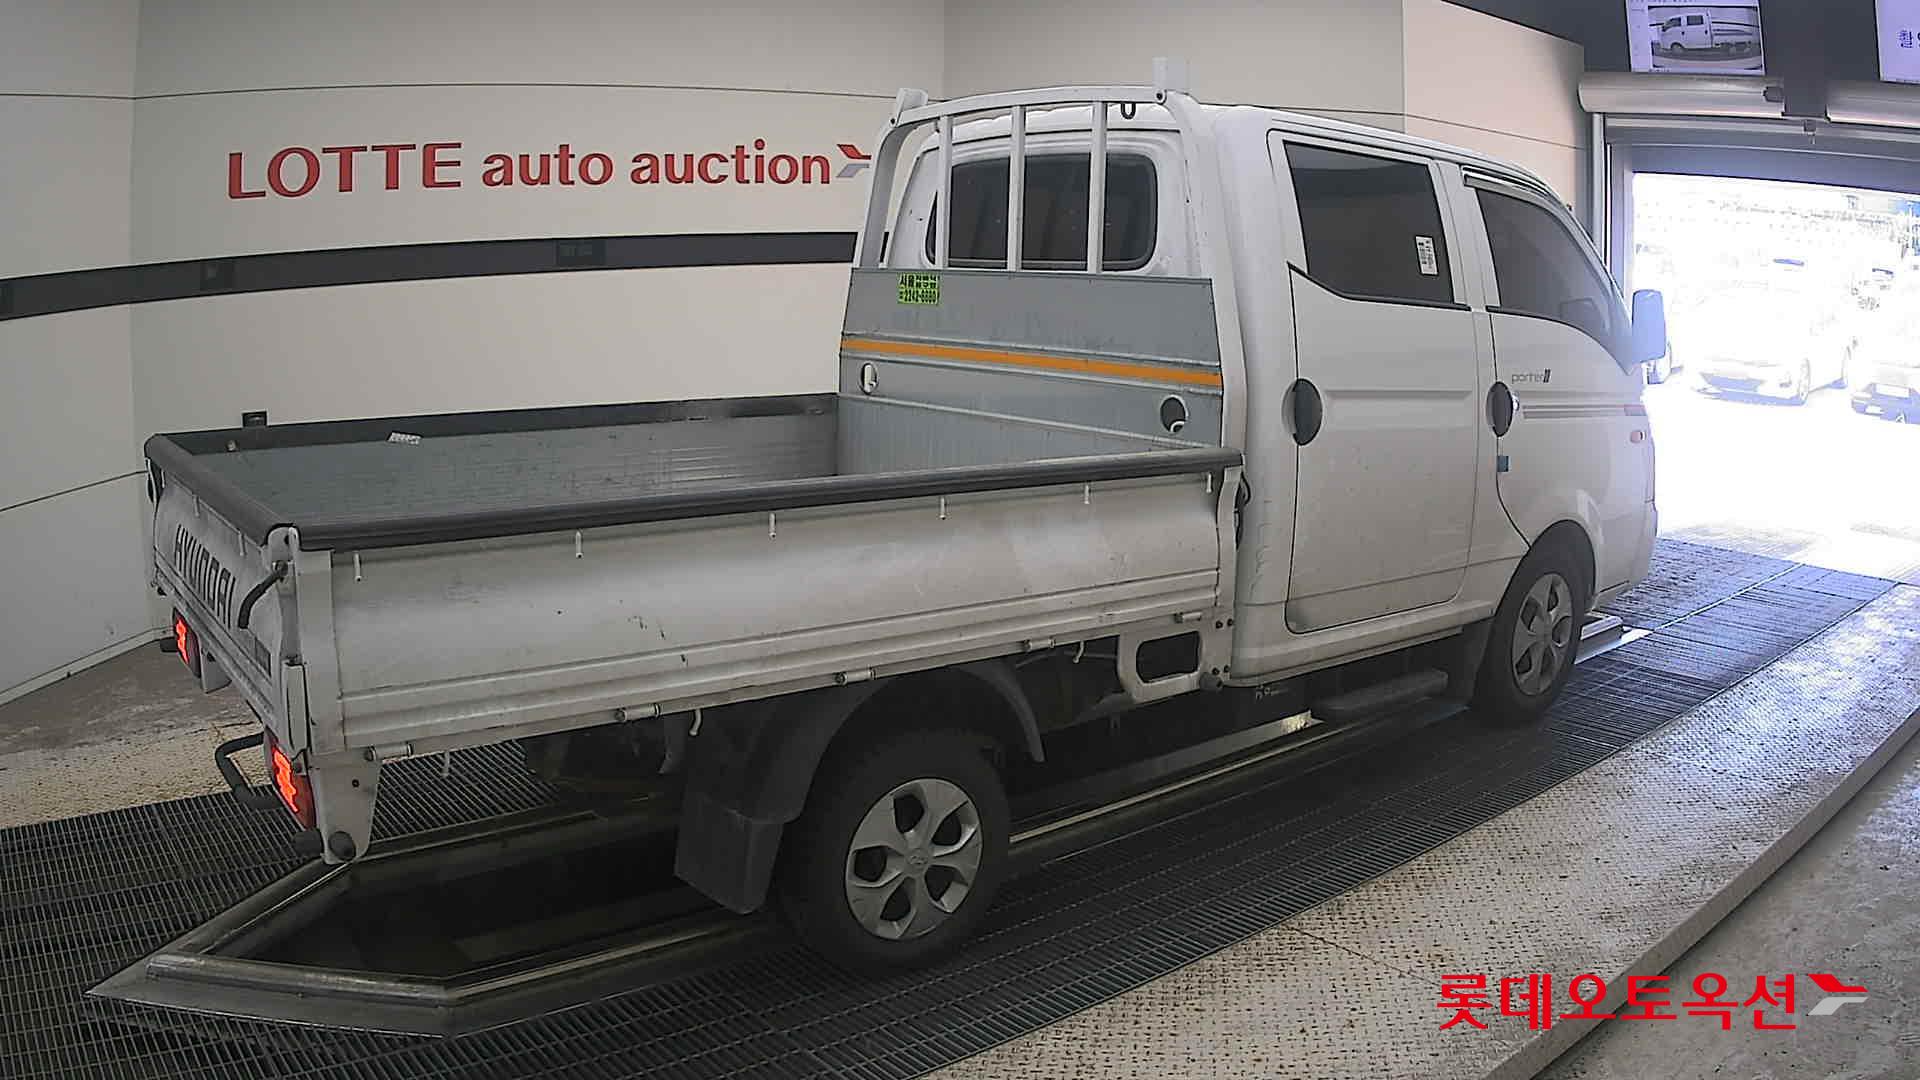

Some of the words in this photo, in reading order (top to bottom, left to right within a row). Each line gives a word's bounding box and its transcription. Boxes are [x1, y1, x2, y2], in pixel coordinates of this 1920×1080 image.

[228, 142, 461, 199] LOTTE
[482, 143, 614, 187] auto
[629, 138, 832, 186] auction
[174, 523, 237, 630] HYUNDAI
